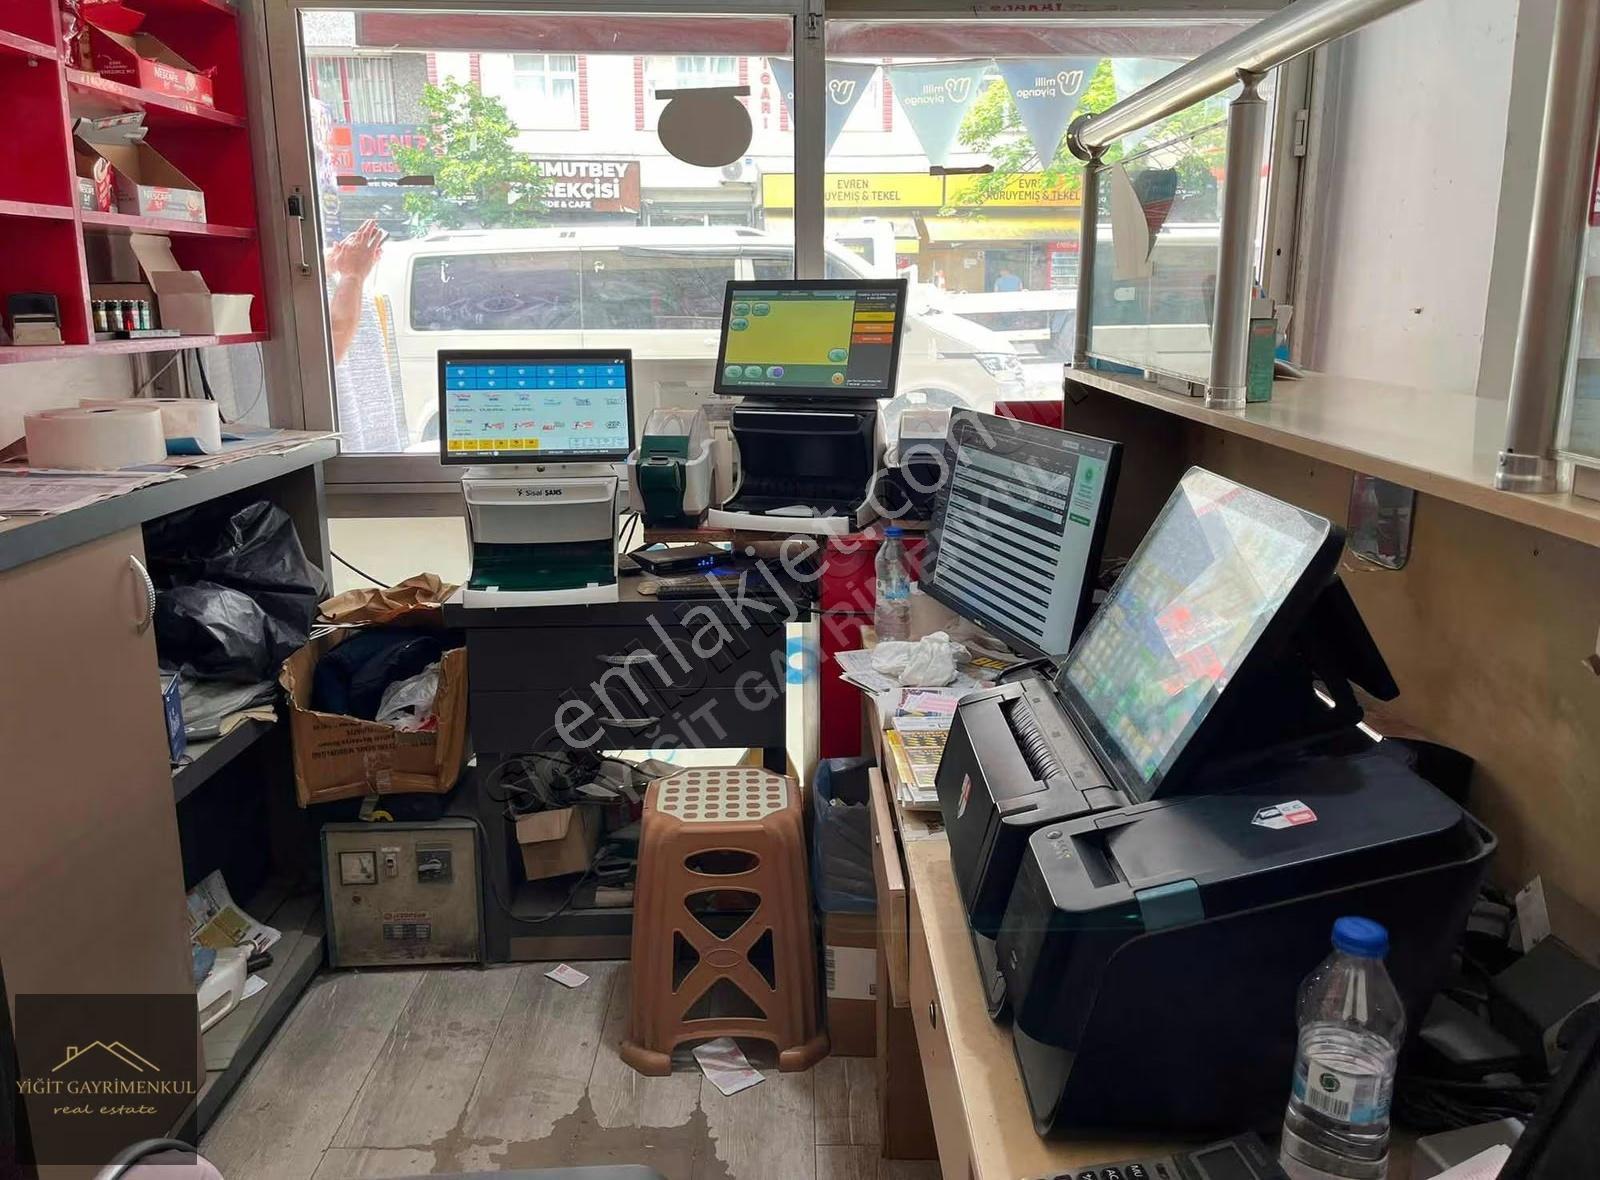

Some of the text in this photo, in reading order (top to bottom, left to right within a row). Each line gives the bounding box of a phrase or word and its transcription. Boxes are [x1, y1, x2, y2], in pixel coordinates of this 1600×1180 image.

[837, 179, 869, 190] EVREN
[861, 190, 869, 201] &
[871, 190, 901, 201] TEKEL
[1042, 191, 1049, 201] &
[1052, 190, 1081, 201] TEKEL
[568, 201, 592, 209] CAFE
